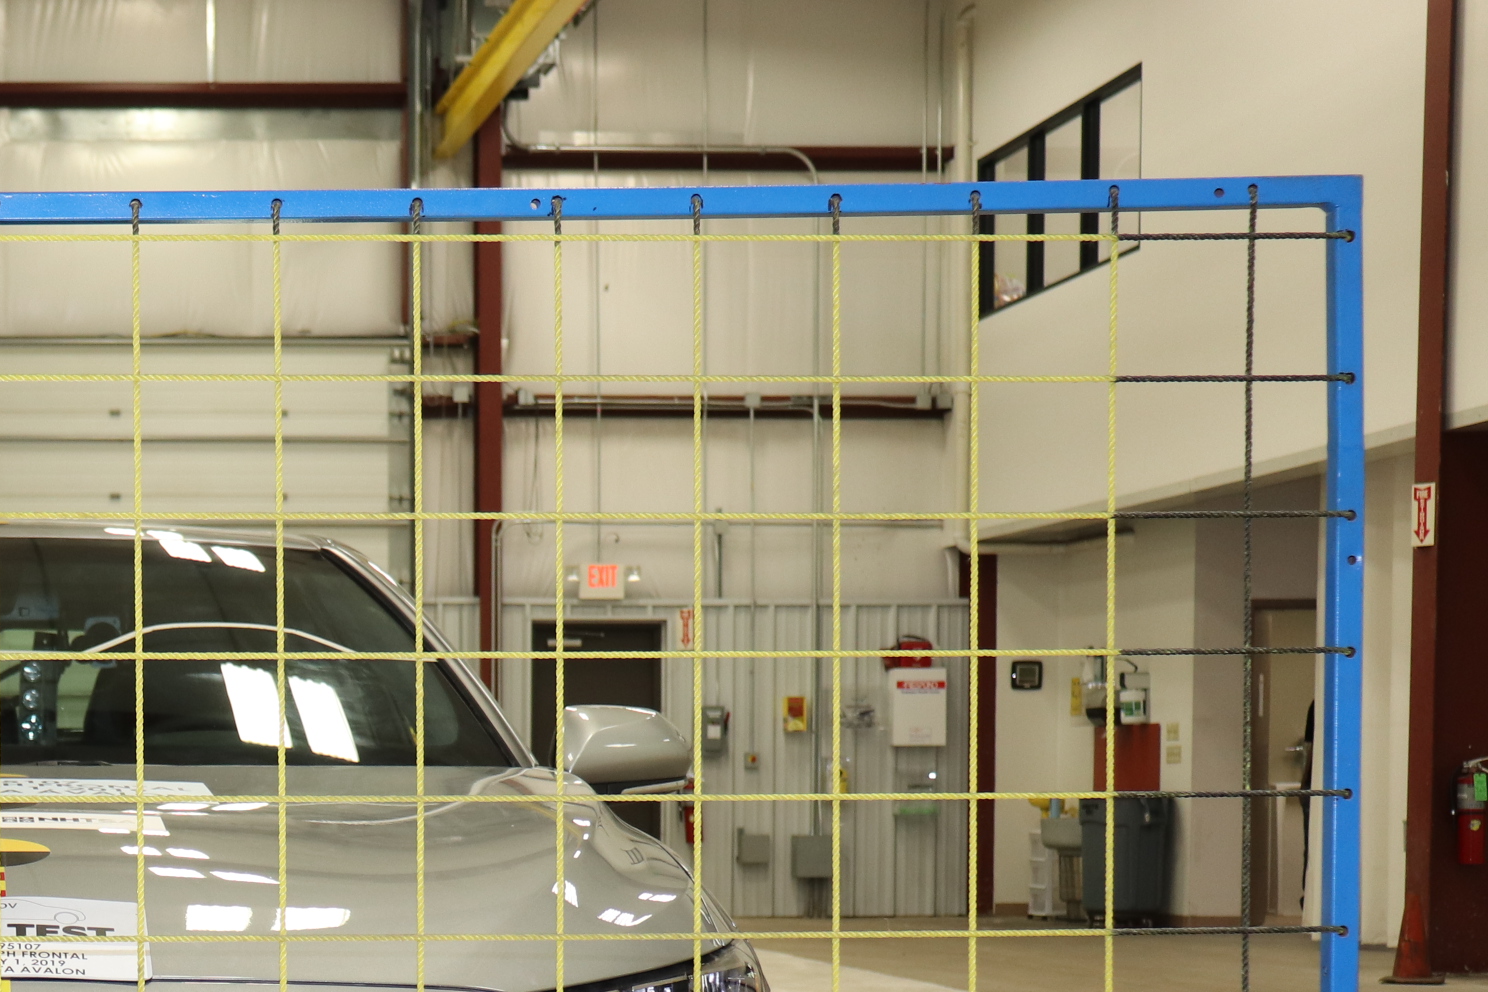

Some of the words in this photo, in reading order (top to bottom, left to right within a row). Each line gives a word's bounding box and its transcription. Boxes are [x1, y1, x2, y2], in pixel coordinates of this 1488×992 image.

[588, 564, 618, 588] EXIT
[7, 923, 114, 938] TEST
[22, 951, 88, 960] FRONTAL
[31, 959, 66, 967] 2019
[20, 966, 87, 976] AVALON
